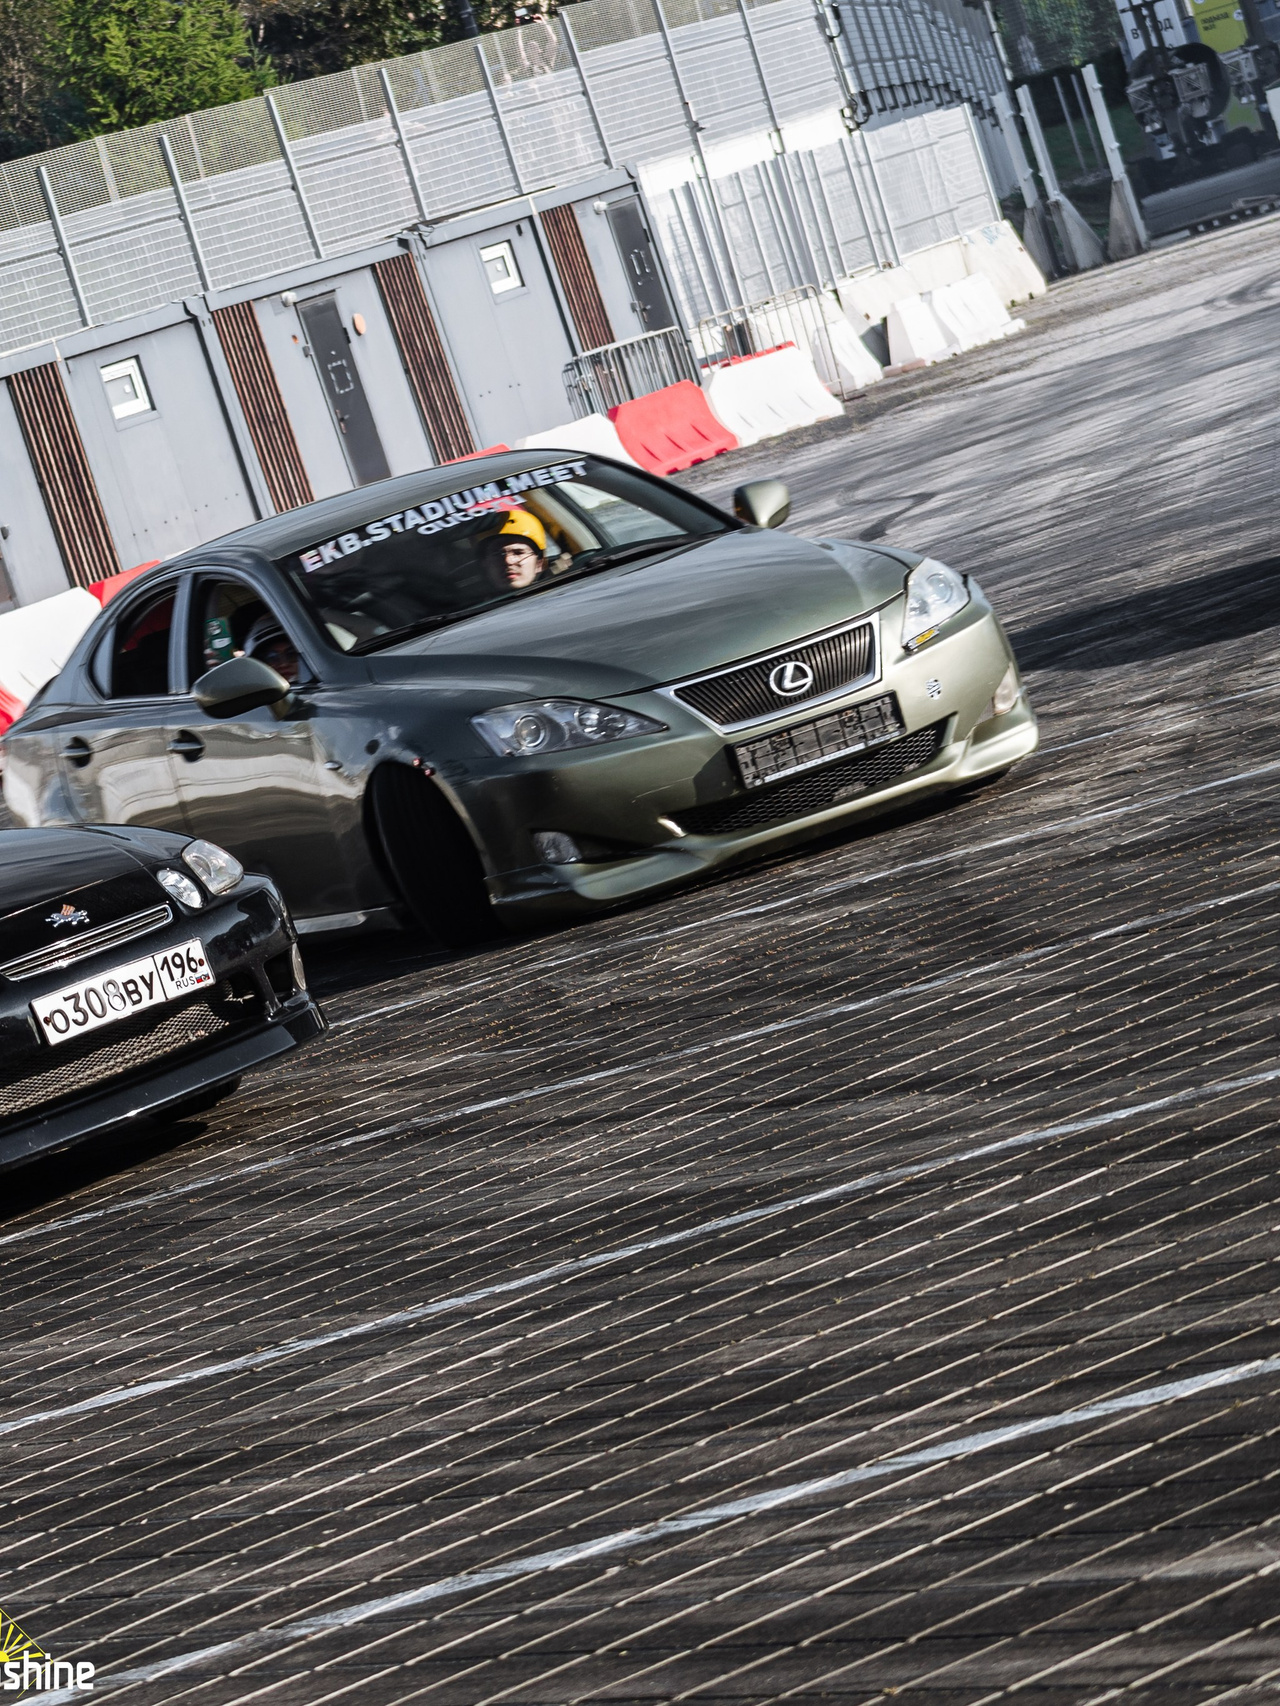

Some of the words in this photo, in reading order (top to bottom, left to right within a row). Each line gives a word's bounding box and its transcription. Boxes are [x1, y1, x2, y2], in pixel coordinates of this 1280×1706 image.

[299, 461, 587, 573] EKB.STADIUM.MEET
[416, 494, 528, 536] auto.ru
[160, 947, 199, 982] 196
[175, 977, 196, 990] RUS
